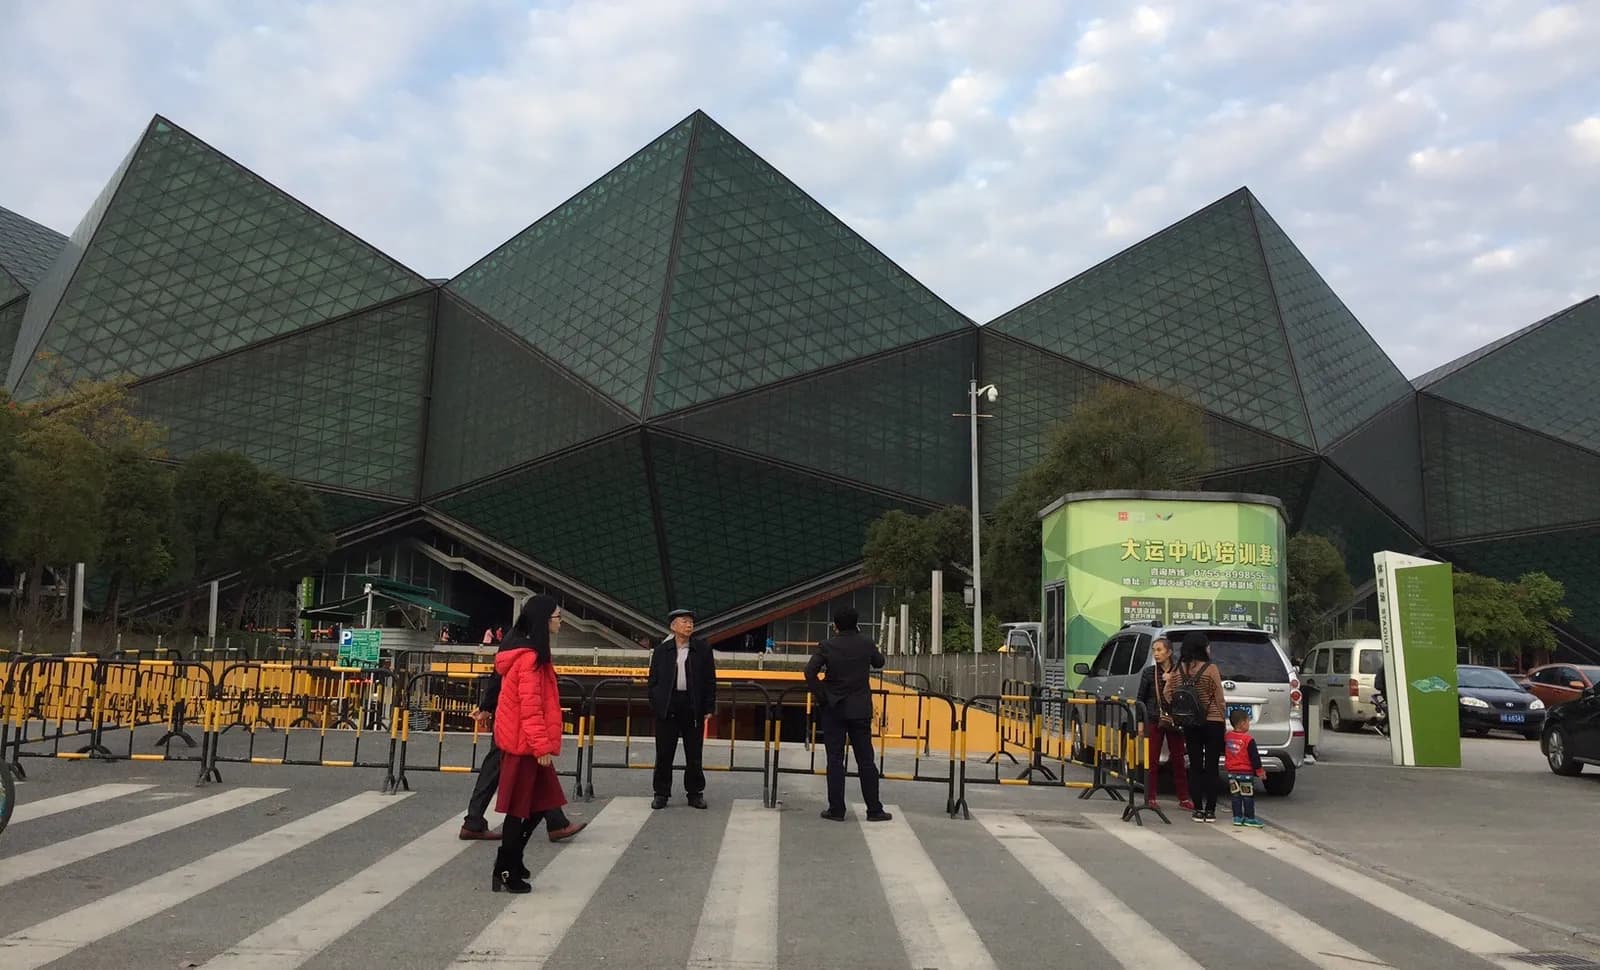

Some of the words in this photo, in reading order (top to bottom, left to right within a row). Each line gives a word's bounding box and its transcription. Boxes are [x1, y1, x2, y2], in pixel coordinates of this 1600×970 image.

[1121, 538, 1277, 567] 大运中心培训基
[341, 631, 352, 645] P
[1381, 608, 1389, 653] STADIUM
